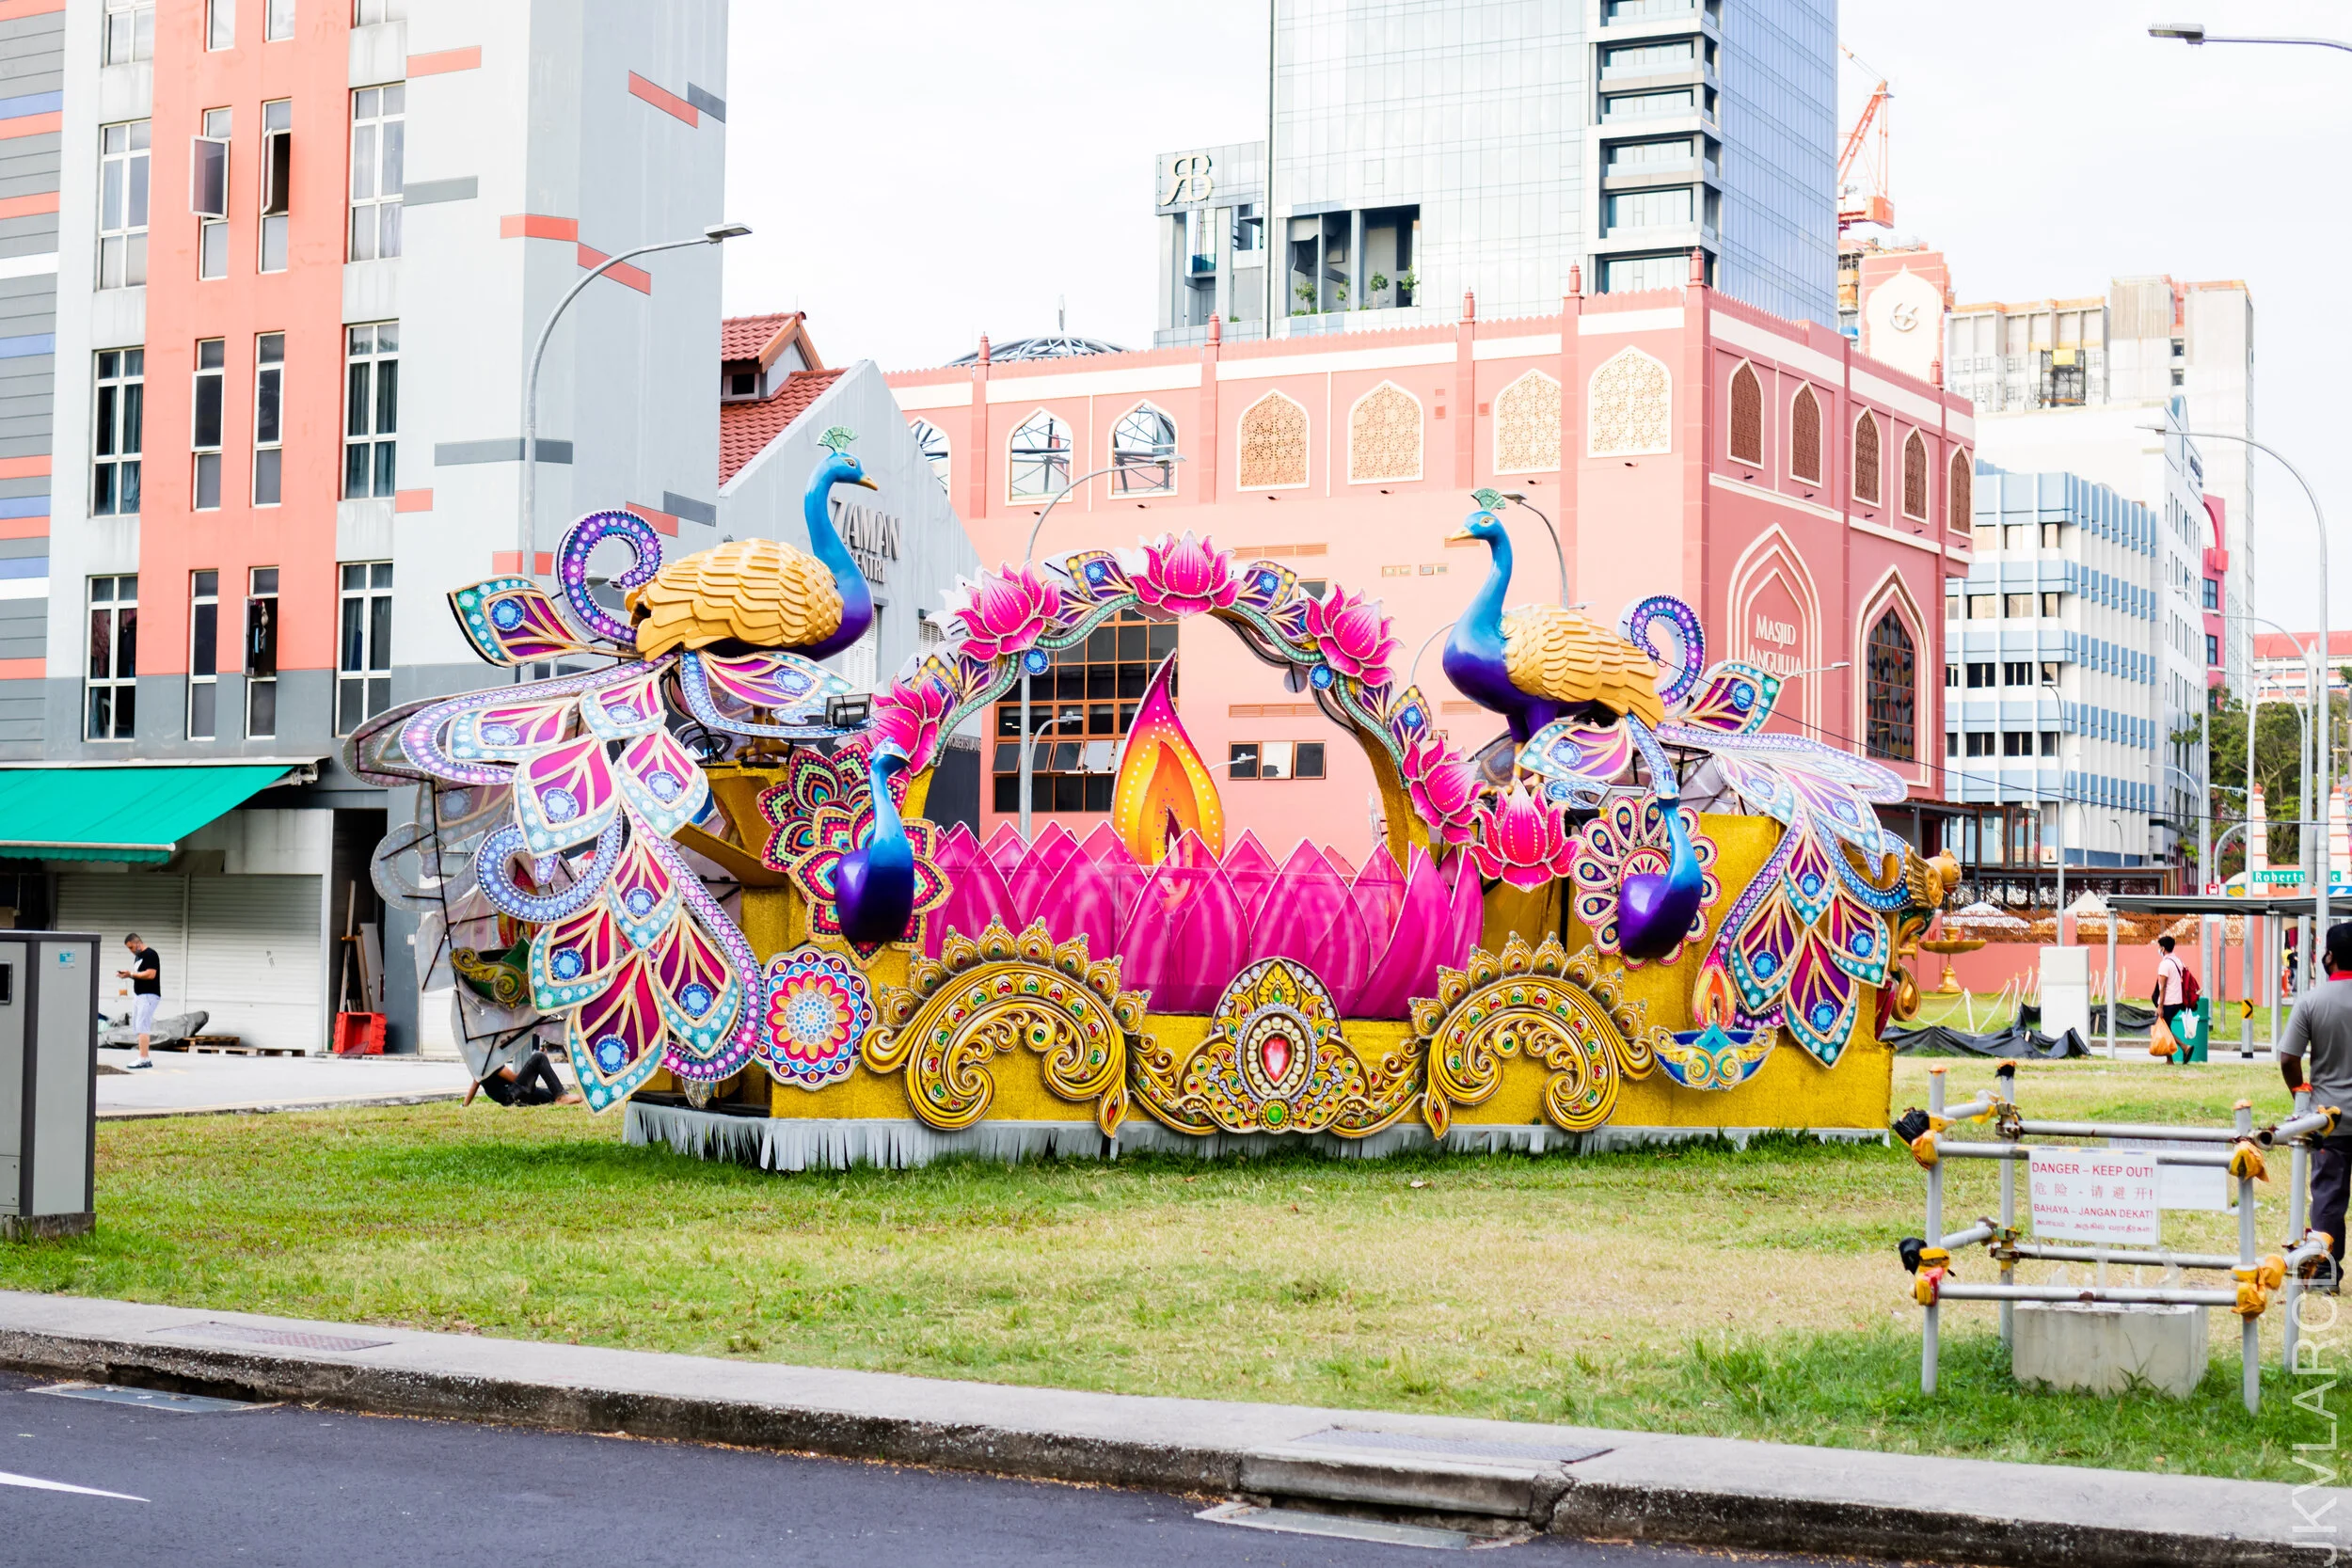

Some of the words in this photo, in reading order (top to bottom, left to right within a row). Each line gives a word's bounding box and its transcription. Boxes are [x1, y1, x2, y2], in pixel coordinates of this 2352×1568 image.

[1756, 613, 1796, 649] MASJID
[2255, 872, 2304, 882] Roberts
[2032, 1162, 2080, 1174] DANGER
[2092, 1165, 2122, 1176] KEEP
[2126, 1166, 2153, 1178] OUT!
[2034, 1204, 2069, 1214] BAHAYA
[2078, 1208, 2117, 1217] JANGAN
[2120, 1209, 2153, 1219] DEKAT!
